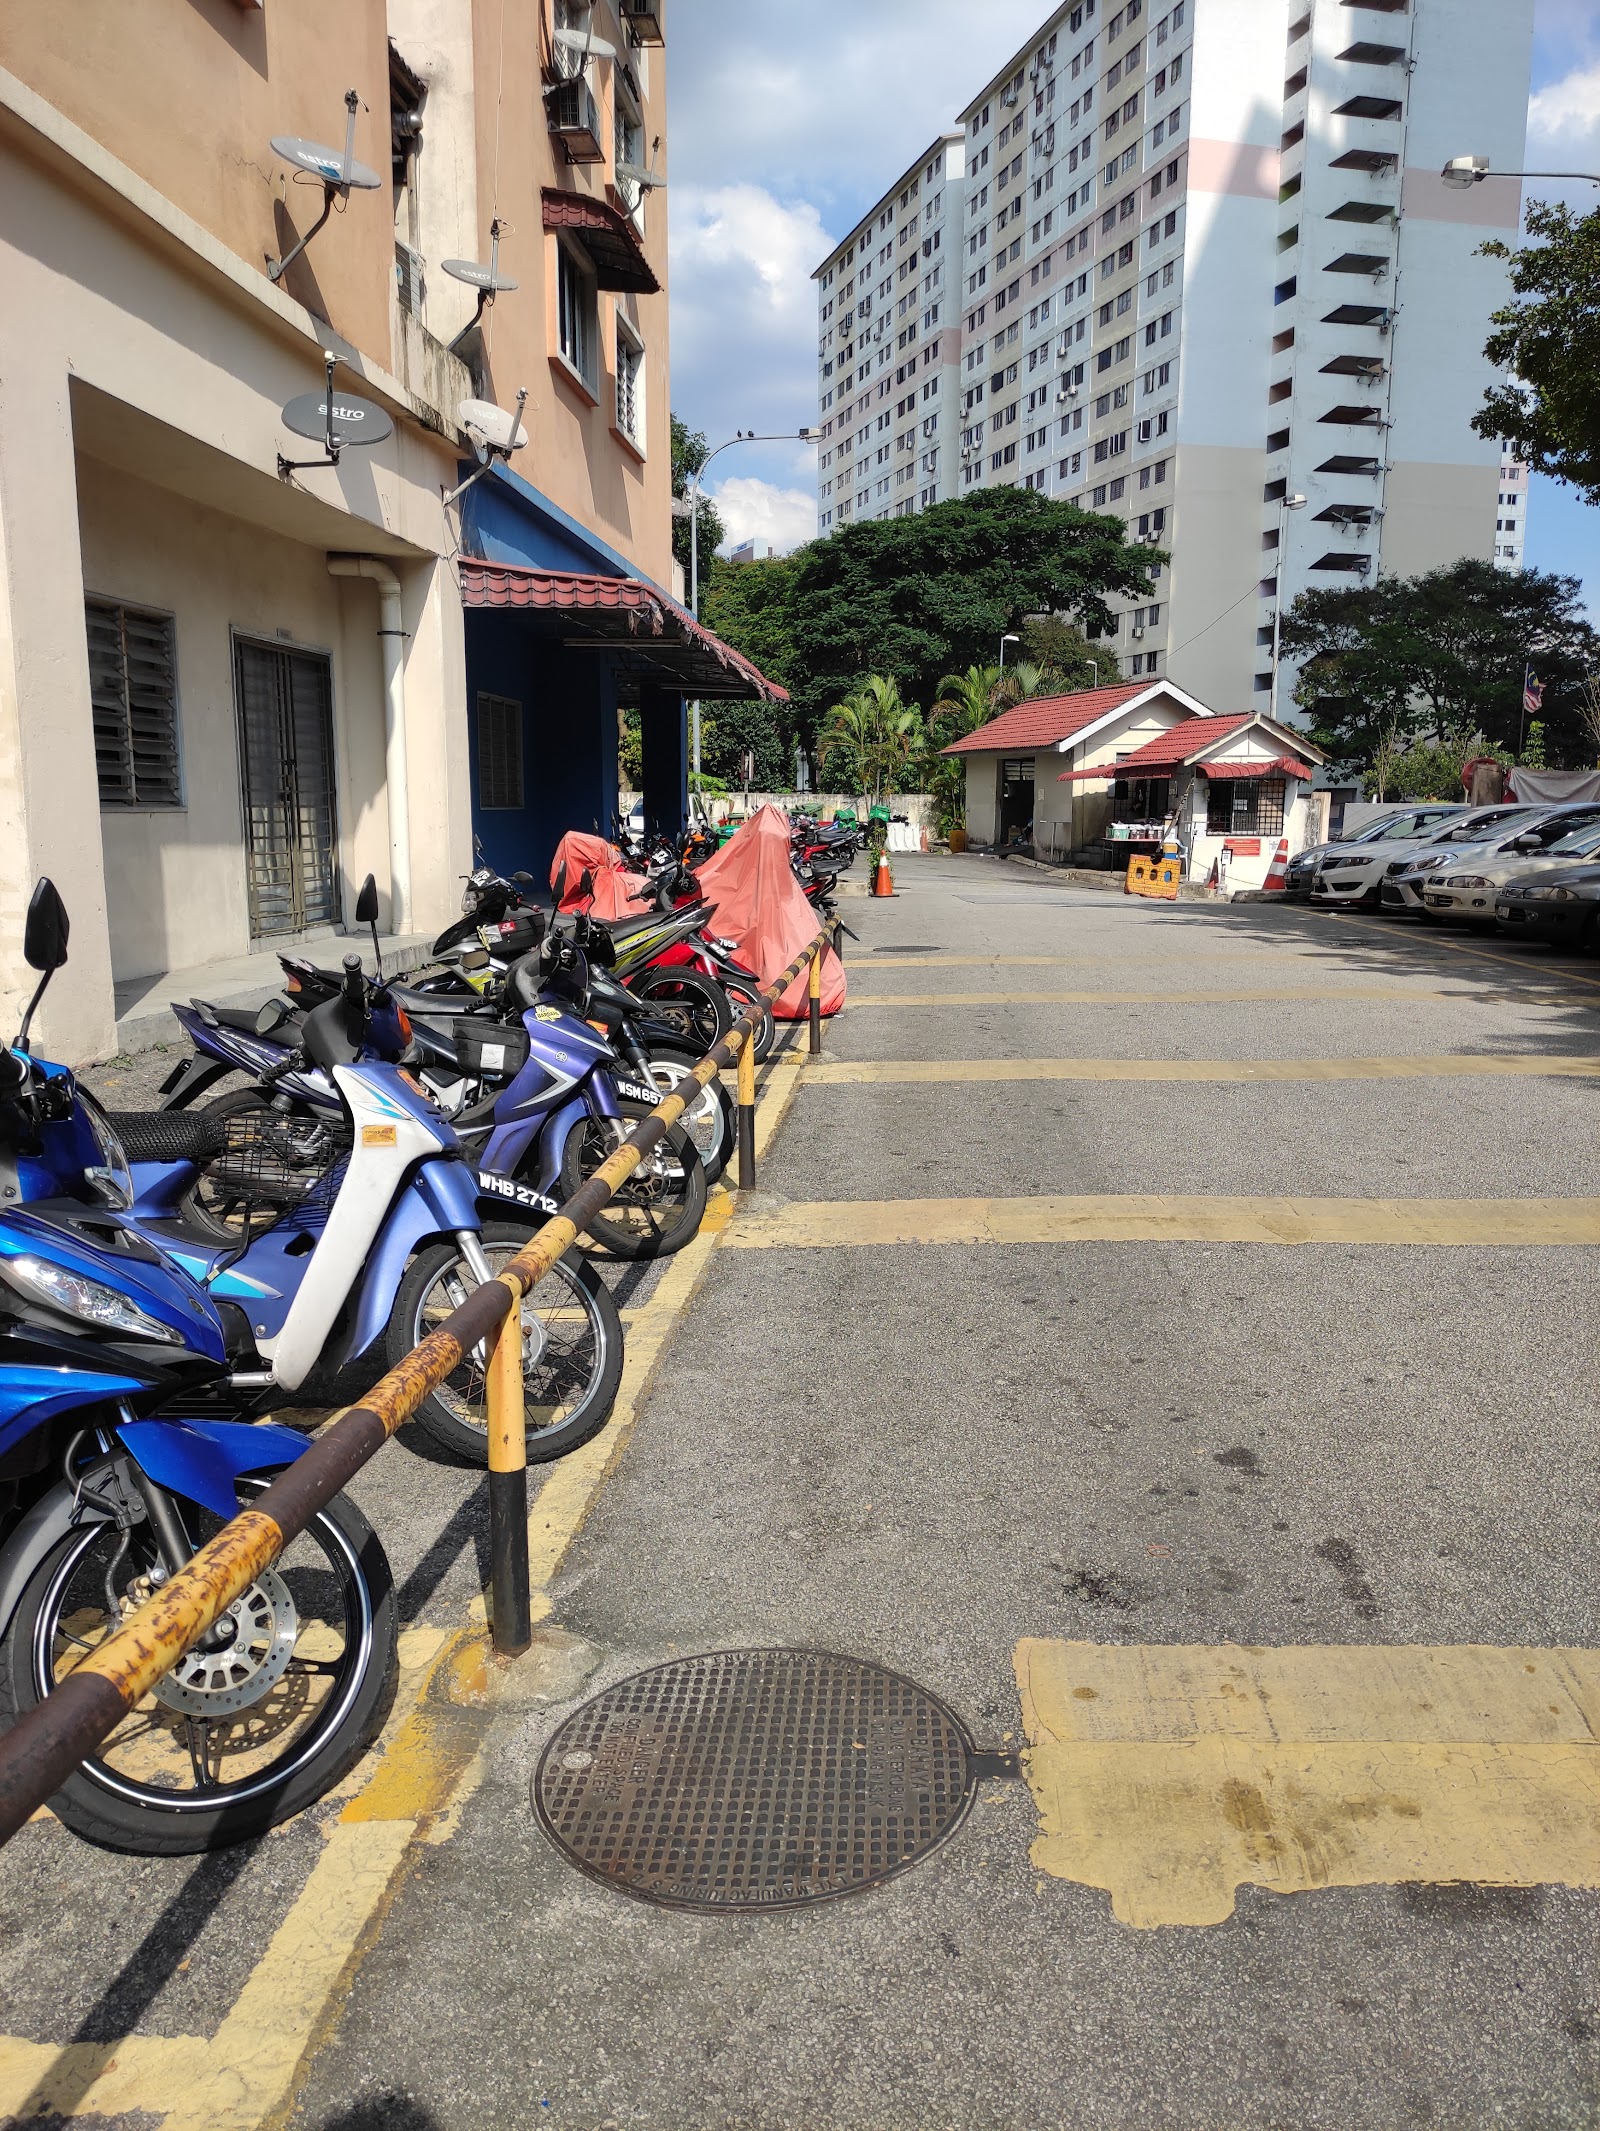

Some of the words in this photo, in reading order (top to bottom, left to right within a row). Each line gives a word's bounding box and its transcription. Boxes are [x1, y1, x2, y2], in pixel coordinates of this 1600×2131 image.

[297, 151, 341, 169] astro
[460, 269, 491, 281] astro
[318, 404, 365, 421] astro
[617, 1080, 642, 1099] WSM
[478, 1171, 515, 1198] WHB
[516, 1186, 558, 1215] 2712
[768, 1653, 817, 1663] CLASS
[609, 1722, 625, 1734] DO
[889, 1720, 905, 1751] RUANG
[602, 1736, 620, 1755] NOT
[616, 1718, 642, 1763] CONFINED
[628, 1738, 656, 1784] DANGER
[910, 1738, 929, 1790] BAHAYA
[590, 1759, 614, 1794] ENTER
[604, 1769, 628, 1803] SPACE
[887, 1755, 905, 1812] TERKURUNG
[668, 1884, 807, 1902] MANUFACTURING
[812, 1875, 848, 1893] LYE
